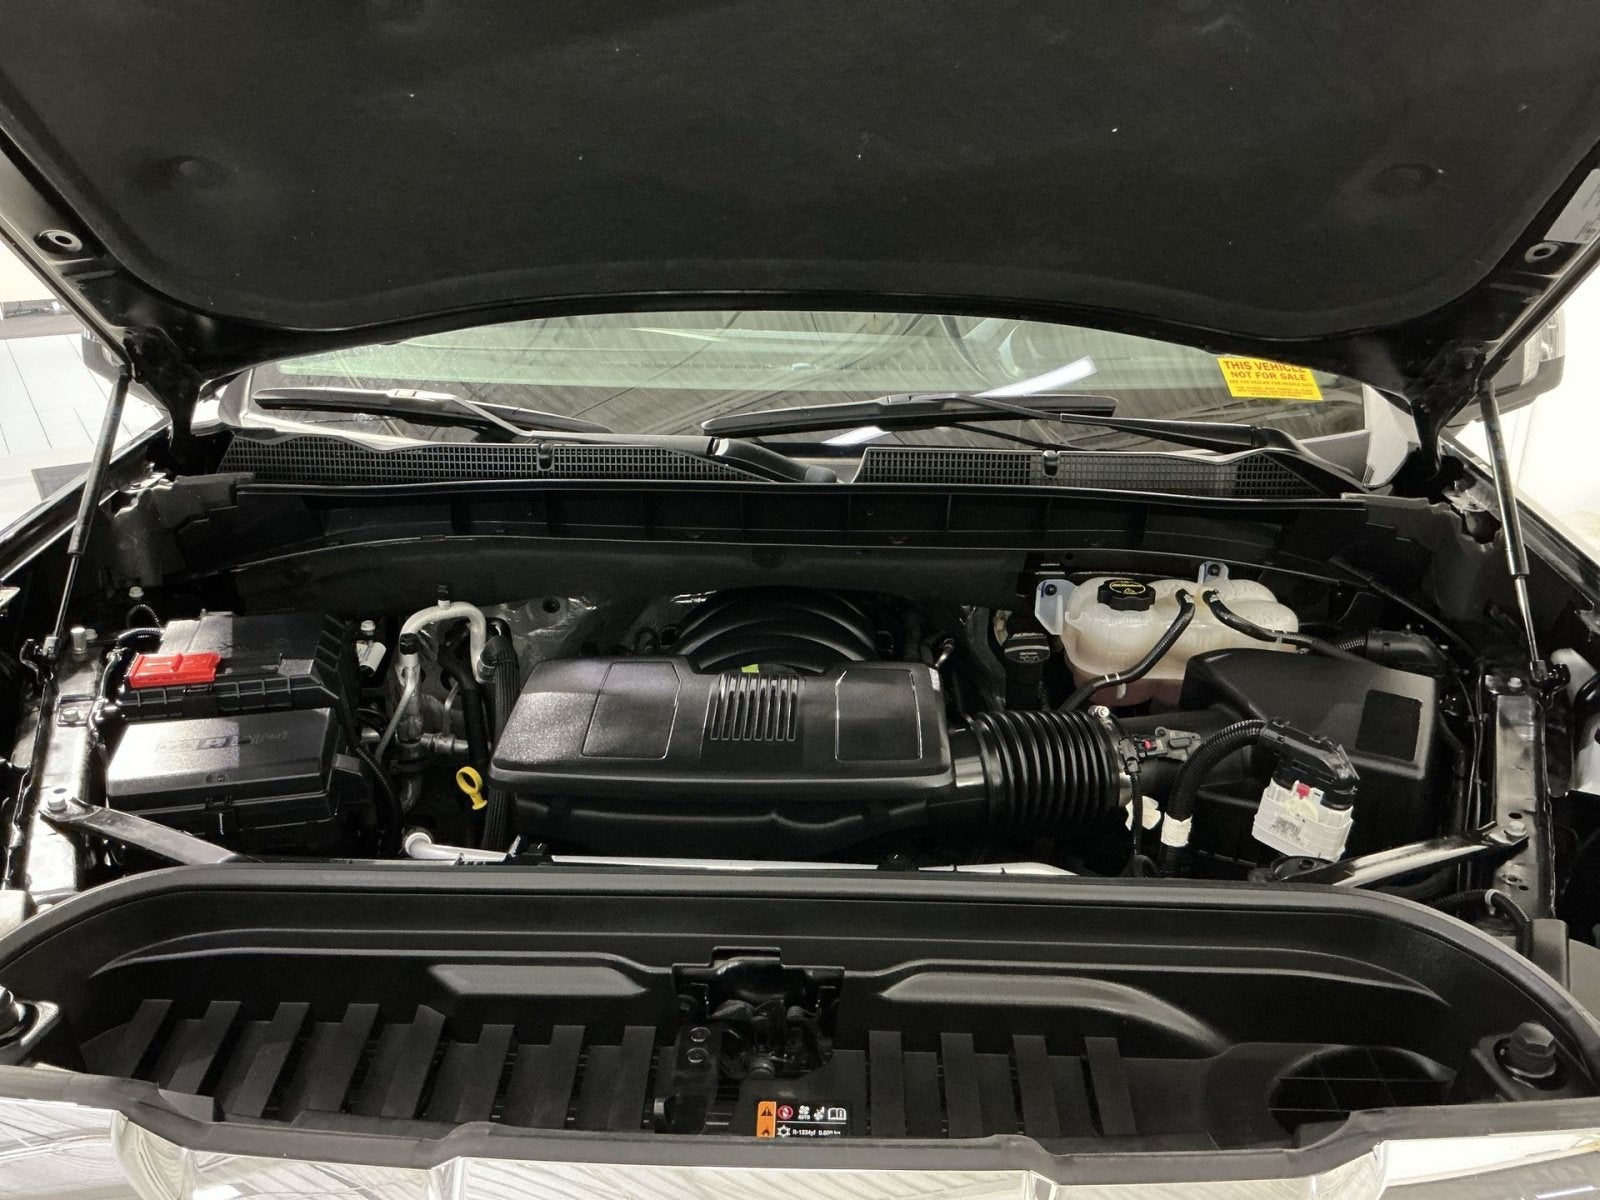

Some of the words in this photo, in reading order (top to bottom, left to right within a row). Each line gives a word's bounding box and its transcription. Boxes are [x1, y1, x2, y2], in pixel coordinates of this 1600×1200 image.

[1223, 361, 1252, 370] THIS
[1230, 371, 1251, 379] NOT
[1255, 372, 1277, 380] FOR
[1280, 373, 1307, 381] SALE
